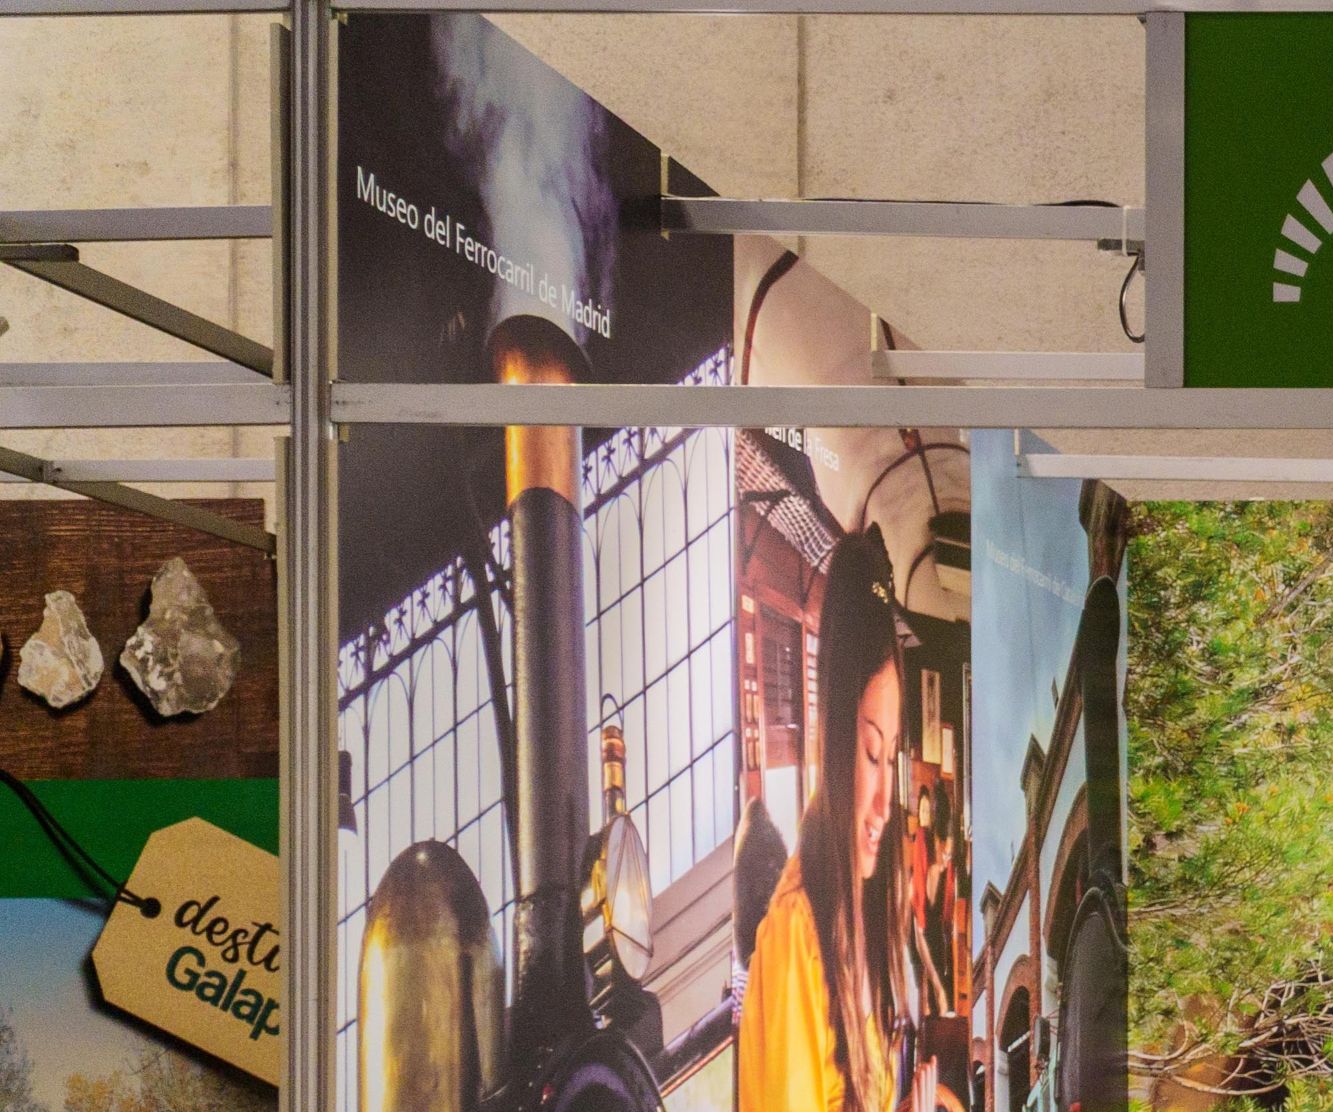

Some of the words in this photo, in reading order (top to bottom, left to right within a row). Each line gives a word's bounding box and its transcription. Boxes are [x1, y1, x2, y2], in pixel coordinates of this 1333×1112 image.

[356, 165, 419, 230] Museo
[423, 206, 450, 248] del
[455, 222, 535, 296] Ferrocarril
[538, 276, 558, 309] de
[561, 284, 611, 339] Madrid
